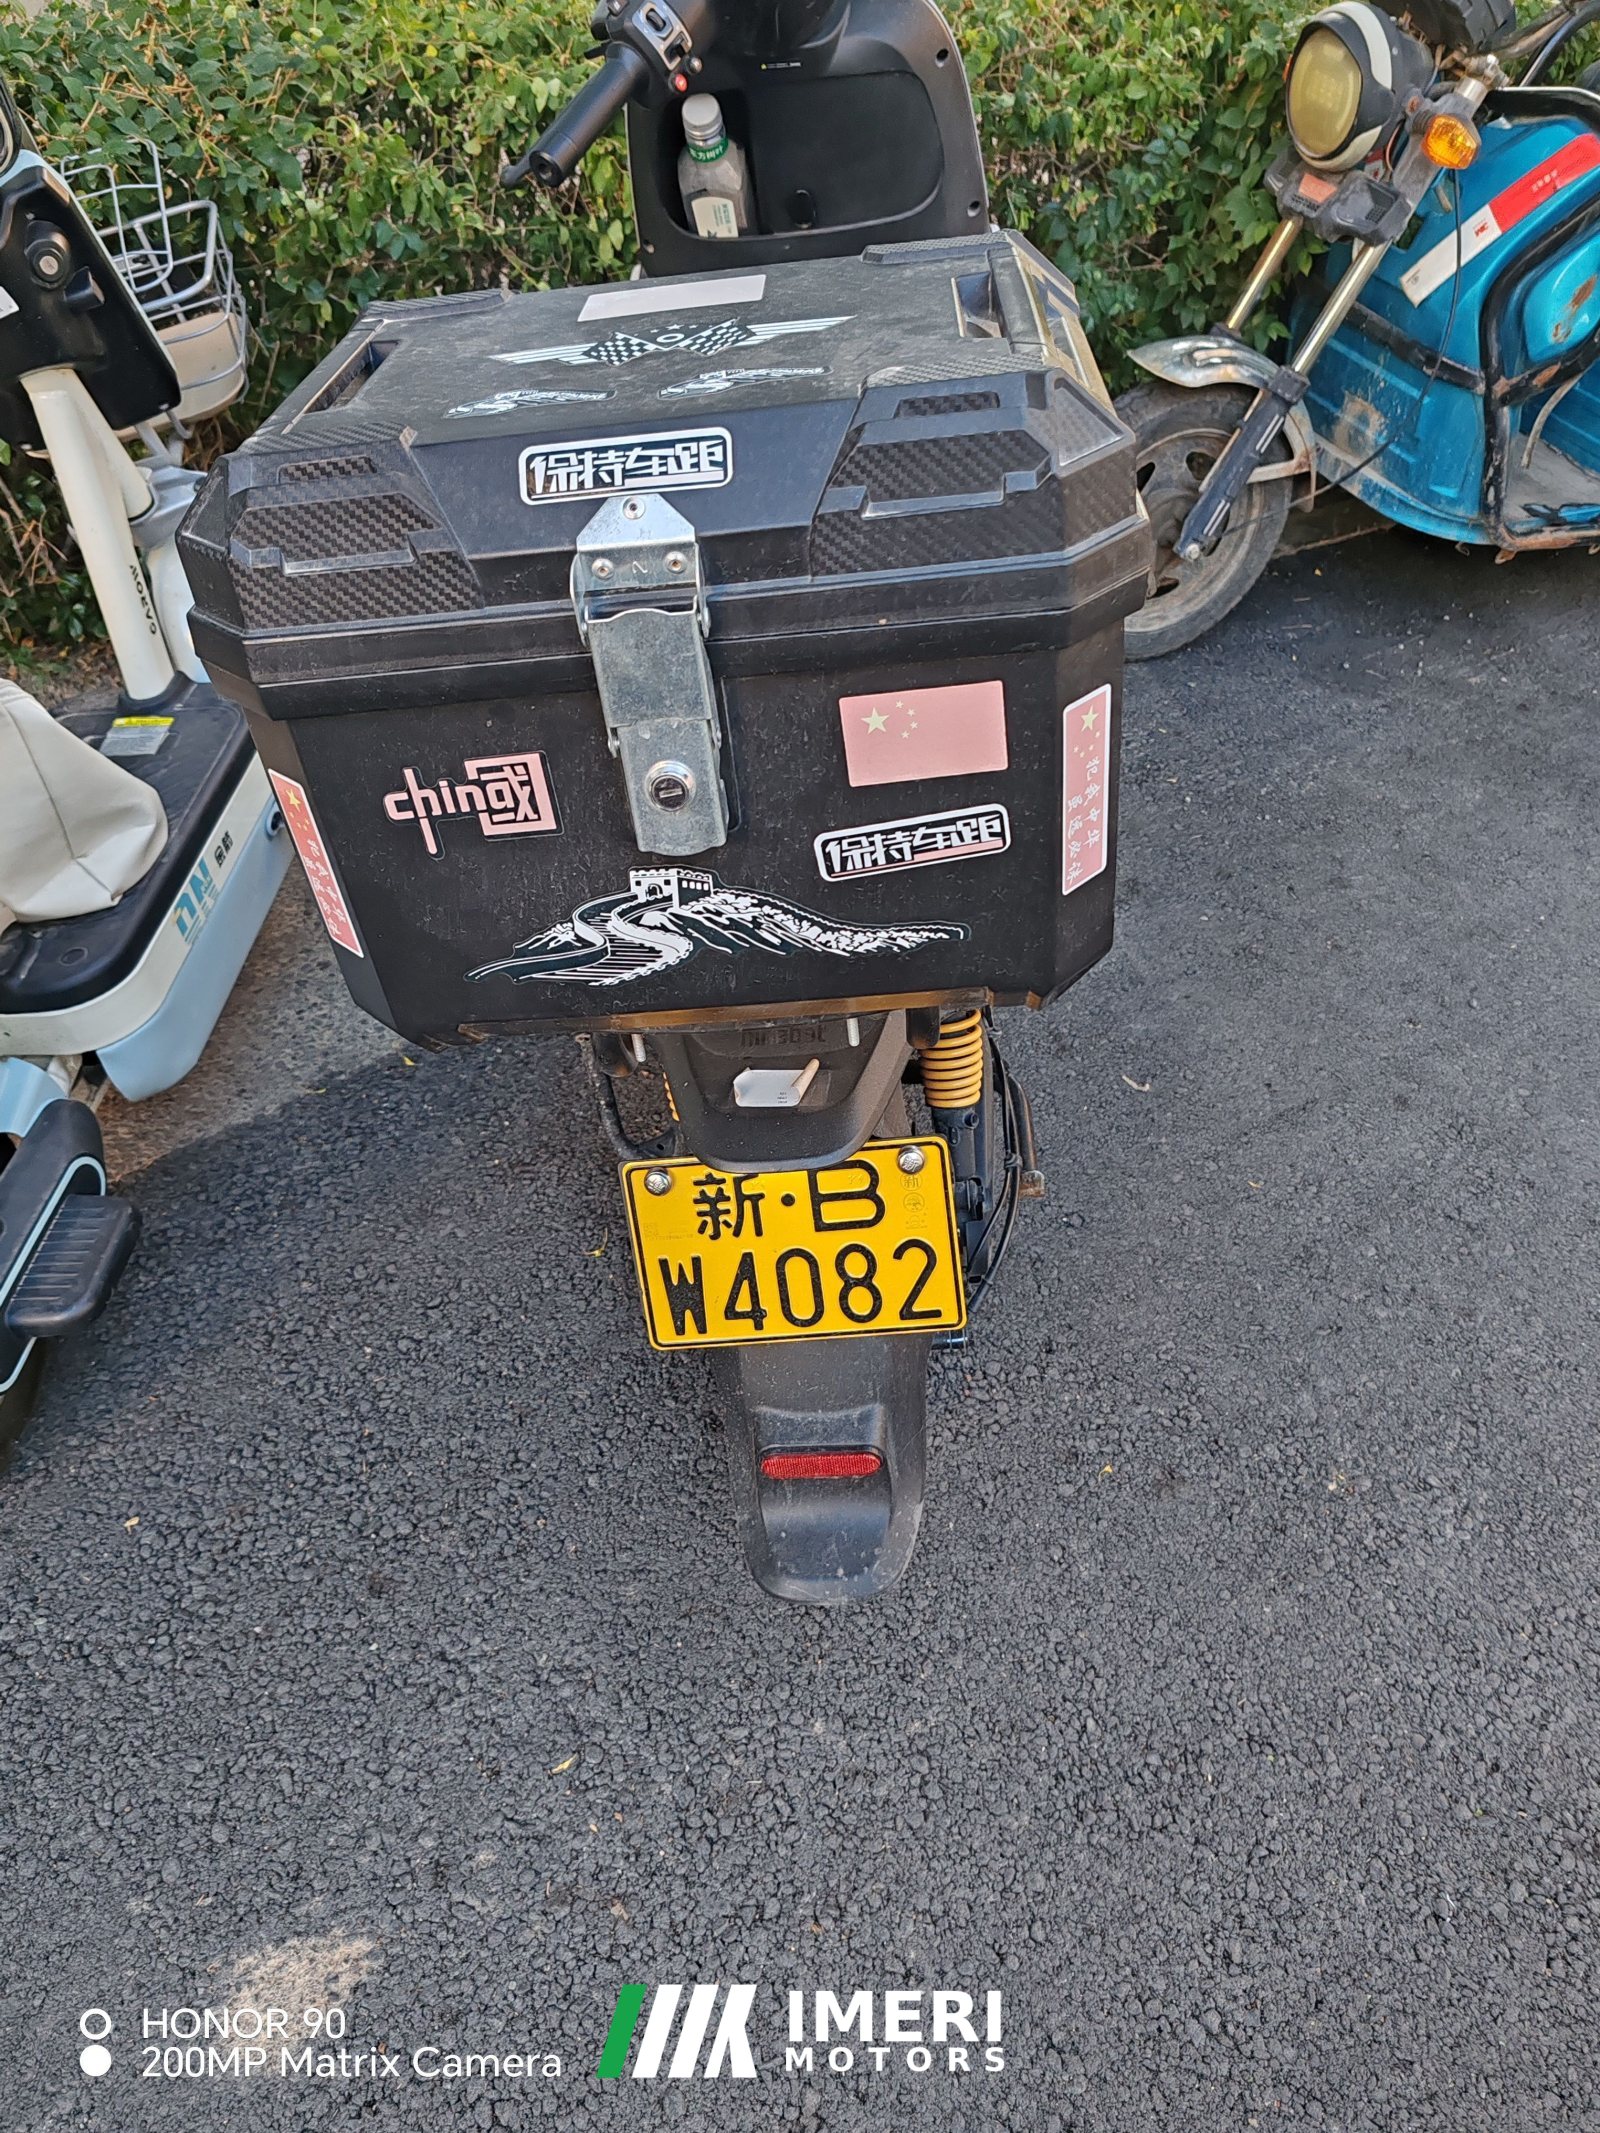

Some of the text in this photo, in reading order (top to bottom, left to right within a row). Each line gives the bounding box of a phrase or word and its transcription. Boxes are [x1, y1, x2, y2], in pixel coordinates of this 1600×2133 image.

[529, 439, 724, 494] 保持车距
[825, 814, 1003, 873] 保持车距
[658, 1238, 942, 1336] W4082
